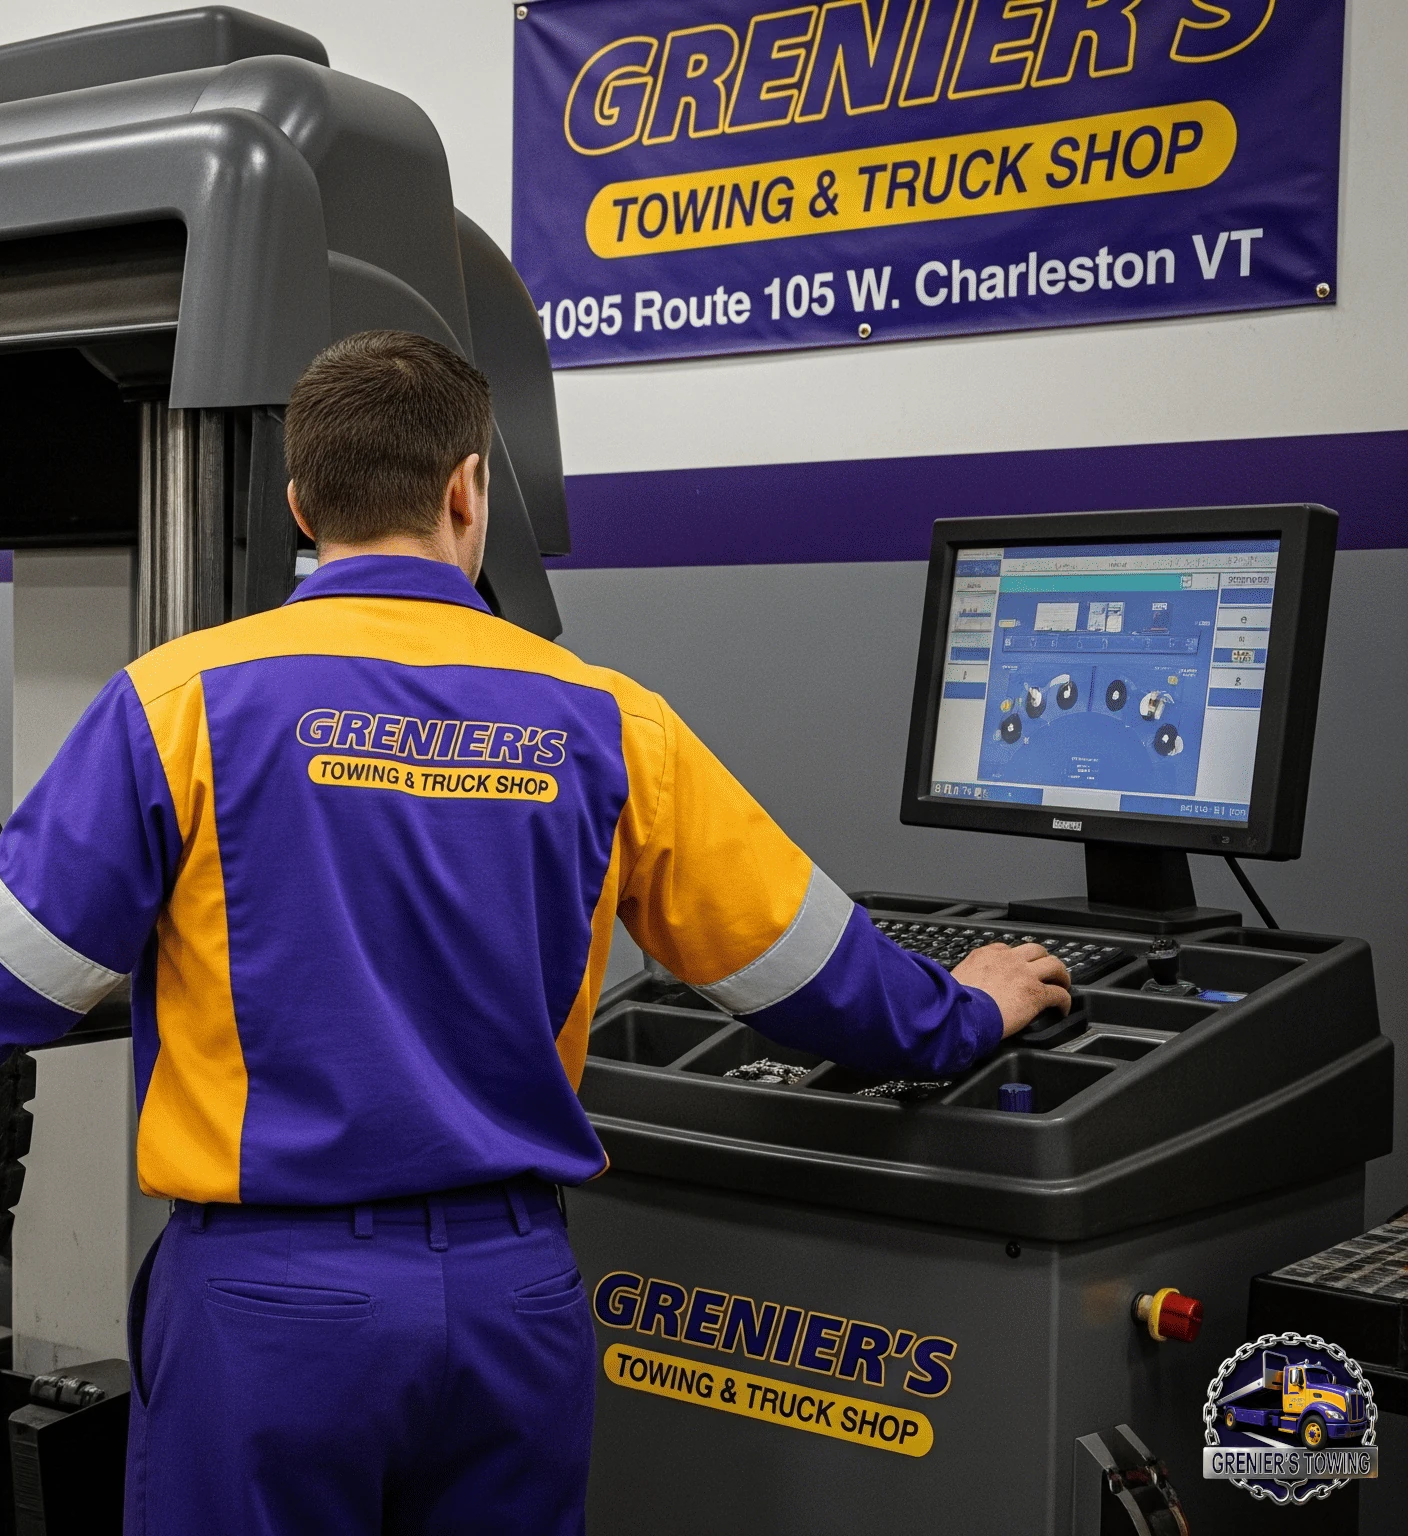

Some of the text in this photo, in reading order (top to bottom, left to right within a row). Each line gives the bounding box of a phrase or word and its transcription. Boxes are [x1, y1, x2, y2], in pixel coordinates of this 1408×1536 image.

[563, 0, 1276, 156] GRENIERS
[613, 120, 1204, 242] TOWING & TRUCK SHOP
[538, 228, 1264, 340] 1095 Route 105 W. Charleston VT
[296, 709, 569, 768] GRENIER'S
[320, 761, 549, 796] TOWING & TRUCK SHOP
[593, 1270, 958, 1399] GRENIER'S
[617, 1352, 920, 1446] TOWING & TRUCK SHOP
